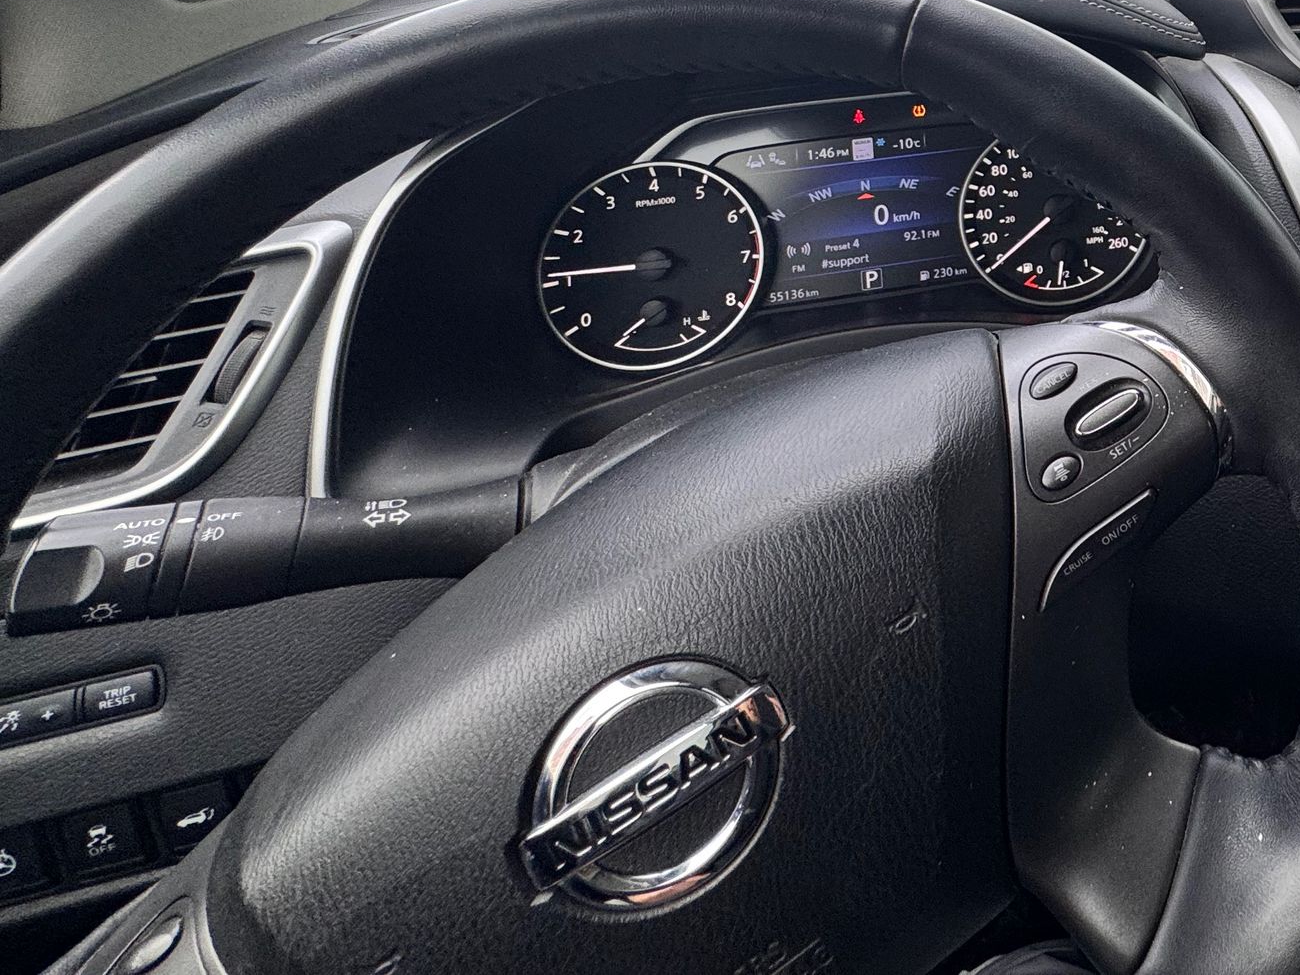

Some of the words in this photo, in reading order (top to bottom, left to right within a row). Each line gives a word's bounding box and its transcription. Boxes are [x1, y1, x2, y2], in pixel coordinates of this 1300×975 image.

[807, 147, 835, 160] 1:46
[836, 148, 849, 157] PM
[991, 164, 1008, 176] 80
[1022, 171, 1033, 179] 60
[649, 178, 660, 192] 4
[860, 180, 871, 191] N
[899, 179, 919, 190] NE
[978, 184, 996, 197] 60
[695, 186, 705, 200] 5
[808, 187, 833, 203] NW
[945, 186, 960, 197] E
[1008, 190, 1019, 198] 40
[606, 196, 616, 210] 3
[727, 210, 738, 224] 6
[767, 209, 786, 222] W
[874, 204, 889, 225] 0
[893, 210, 921, 223] km/h
[976, 208, 993, 220] 40
[1005, 215, 1015, 224] 20
[573, 230, 583, 244] 2
[982, 232, 998, 244] 20
[1086, 236, 1104, 245] MPH
[1108, 237, 1129, 250] 260
[825, 241, 851, 252] Preset
[853, 238, 860, 248] 4
[740, 249, 751, 264] 7
[821, 254, 870, 269] #support
[1083, 258, 1088, 267] 1
[792, 264, 806, 273] FM
[933, 267, 953, 279] 230
[954, 267, 968, 275] km
[1036, 265, 1043, 273] 0
[865, 270, 879, 289] P
[725, 292, 736, 306] 8
[580, 312, 592, 327] 0
[683, 317, 691, 326] H
[207, 511, 243, 522] OFF
[113, 518, 166, 531] AUTO
[1101, 513, 1139, 545] ON/OFF
[1063, 551, 1093, 576] CRUISE
[104, 686, 132, 699] TRIP
[99, 693, 137, 710] RESET
[554, 709, 760, 872] NISSAN
[89, 842, 117, 857] OFF
